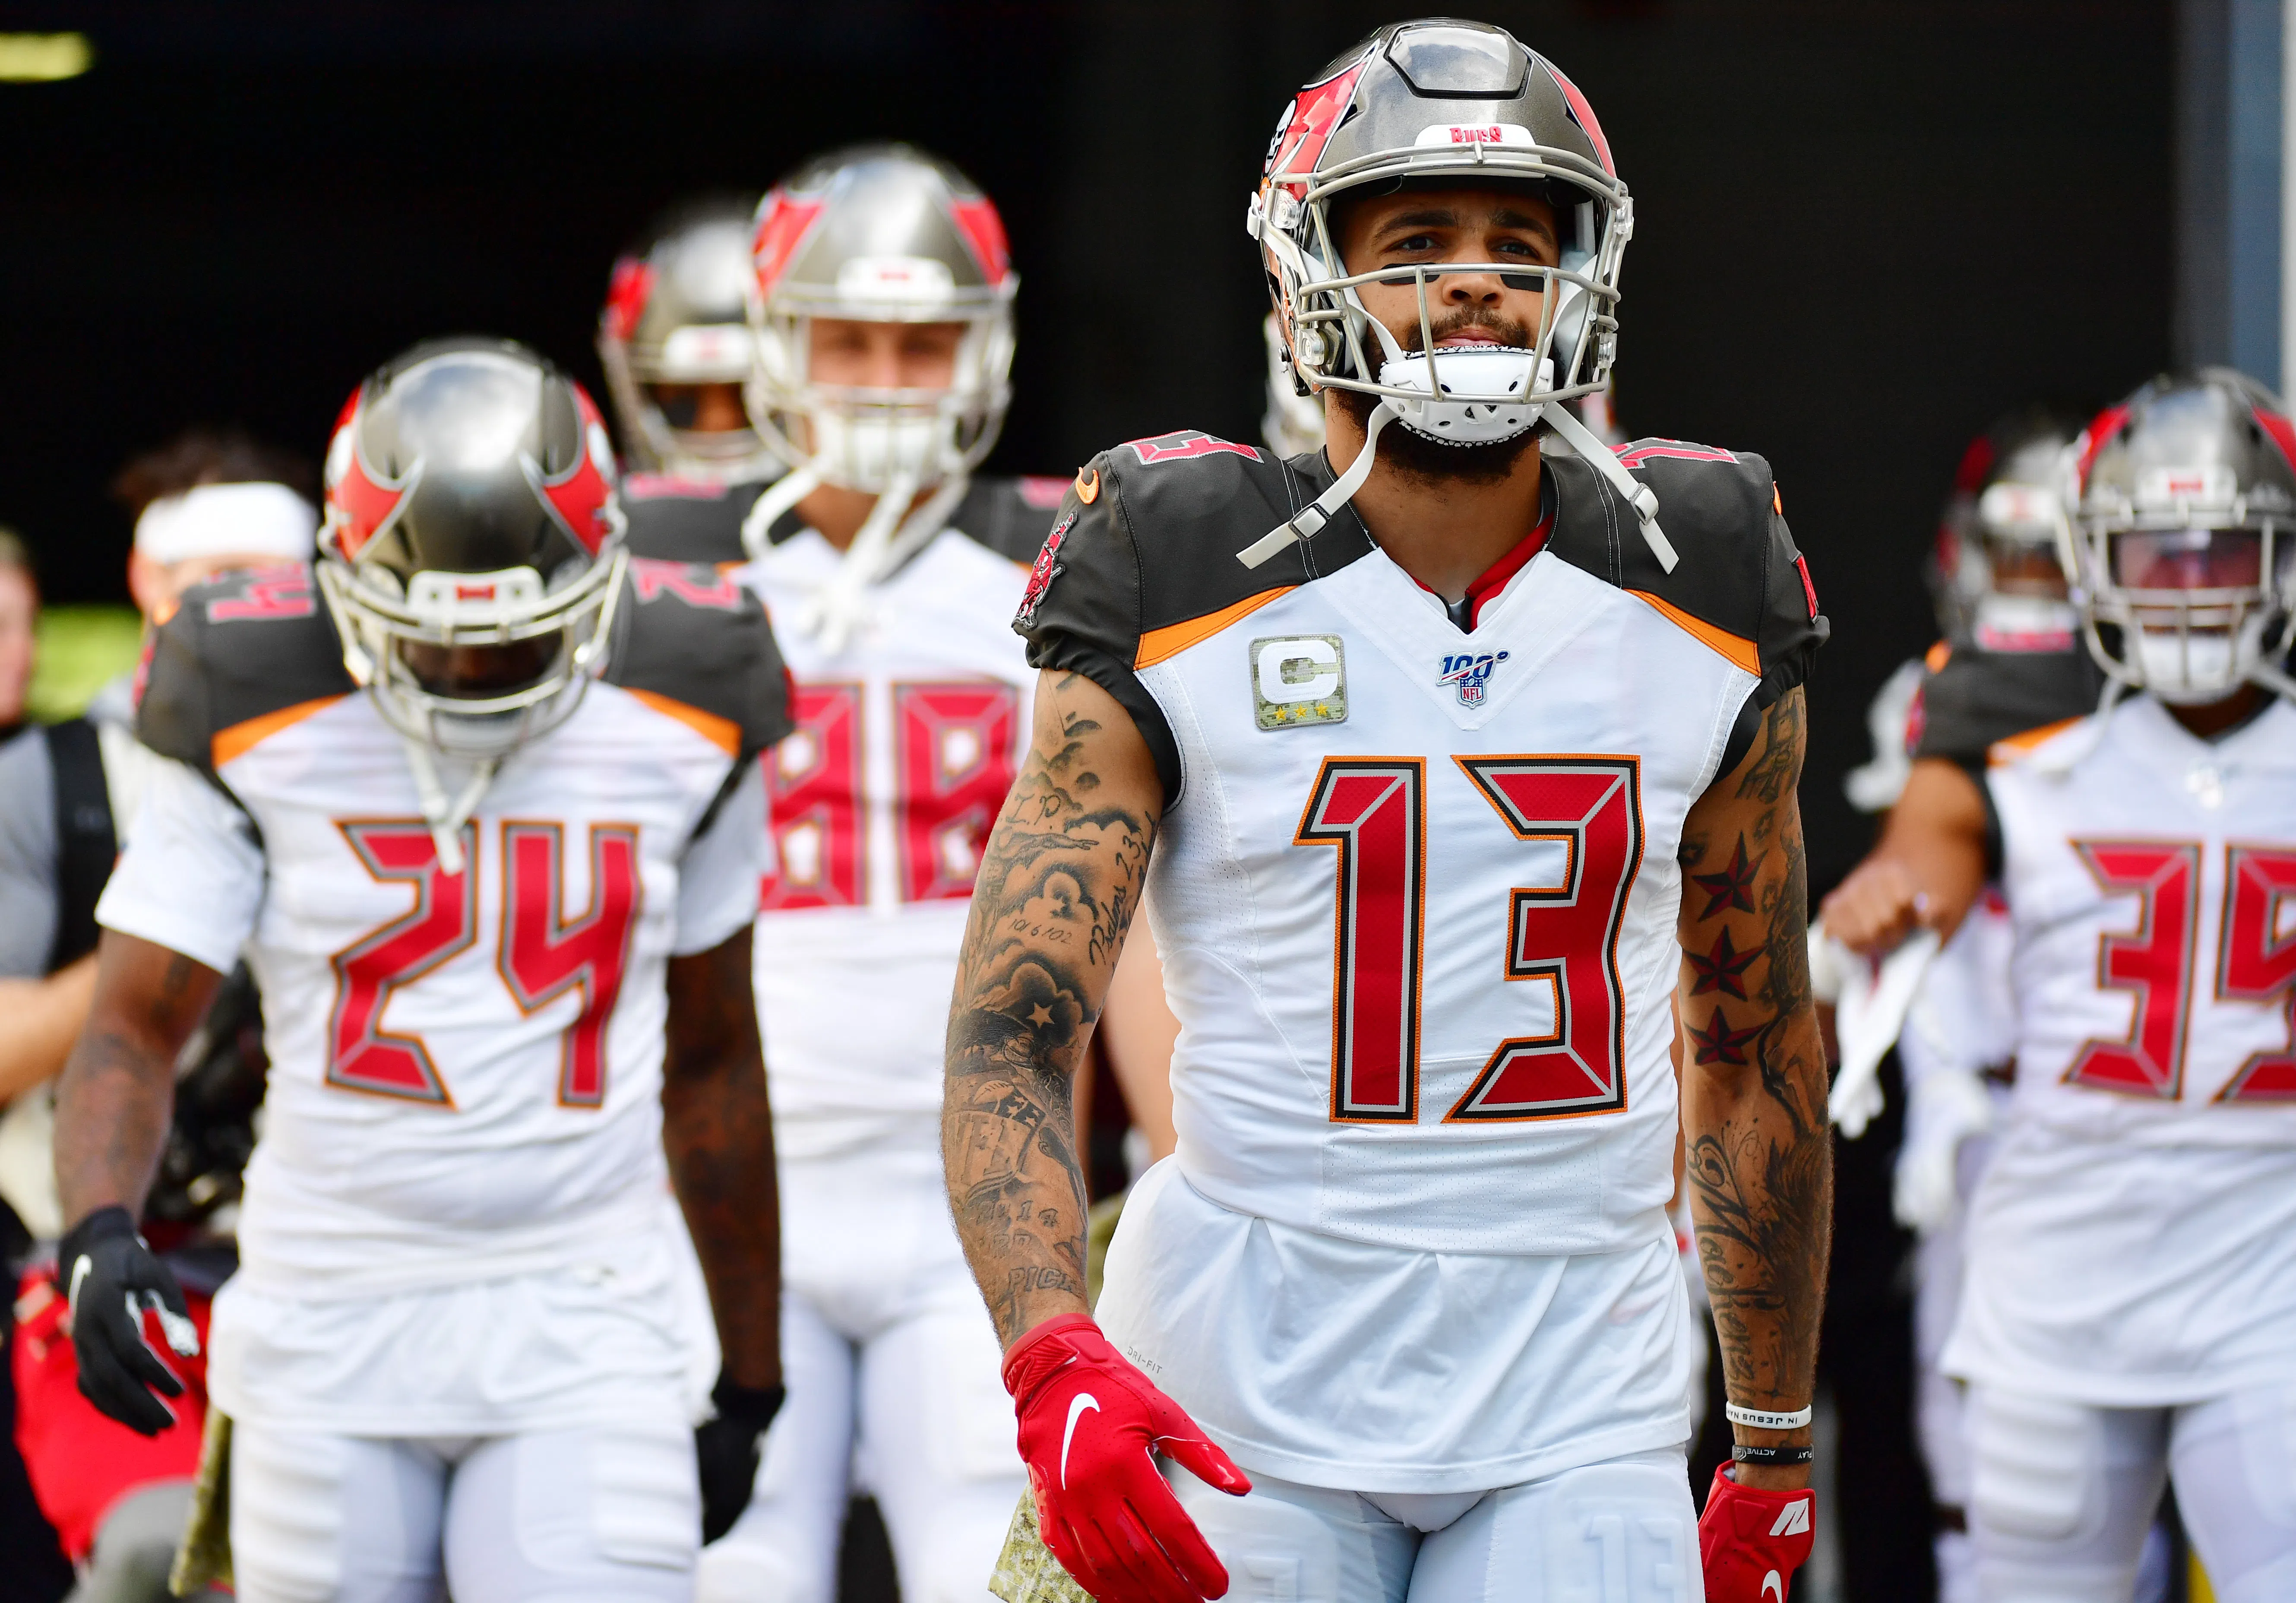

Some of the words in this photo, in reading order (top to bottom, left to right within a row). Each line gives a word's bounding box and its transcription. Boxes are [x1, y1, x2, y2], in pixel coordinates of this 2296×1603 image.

[1258, 640, 1339, 705] C
[1442, 655, 1494, 680] 100
[1462, 687, 1482, 701] NFL
[758, 681, 1021, 912] 88
[1292, 754, 1645, 1125] 13
[323, 816, 644, 1112] 24
[1127, 1346, 1163, 1374] DRI-FIT
[1743, 1414, 1783, 1425] JESUS
[1747, 1448, 1776, 1456] ACTIVE
